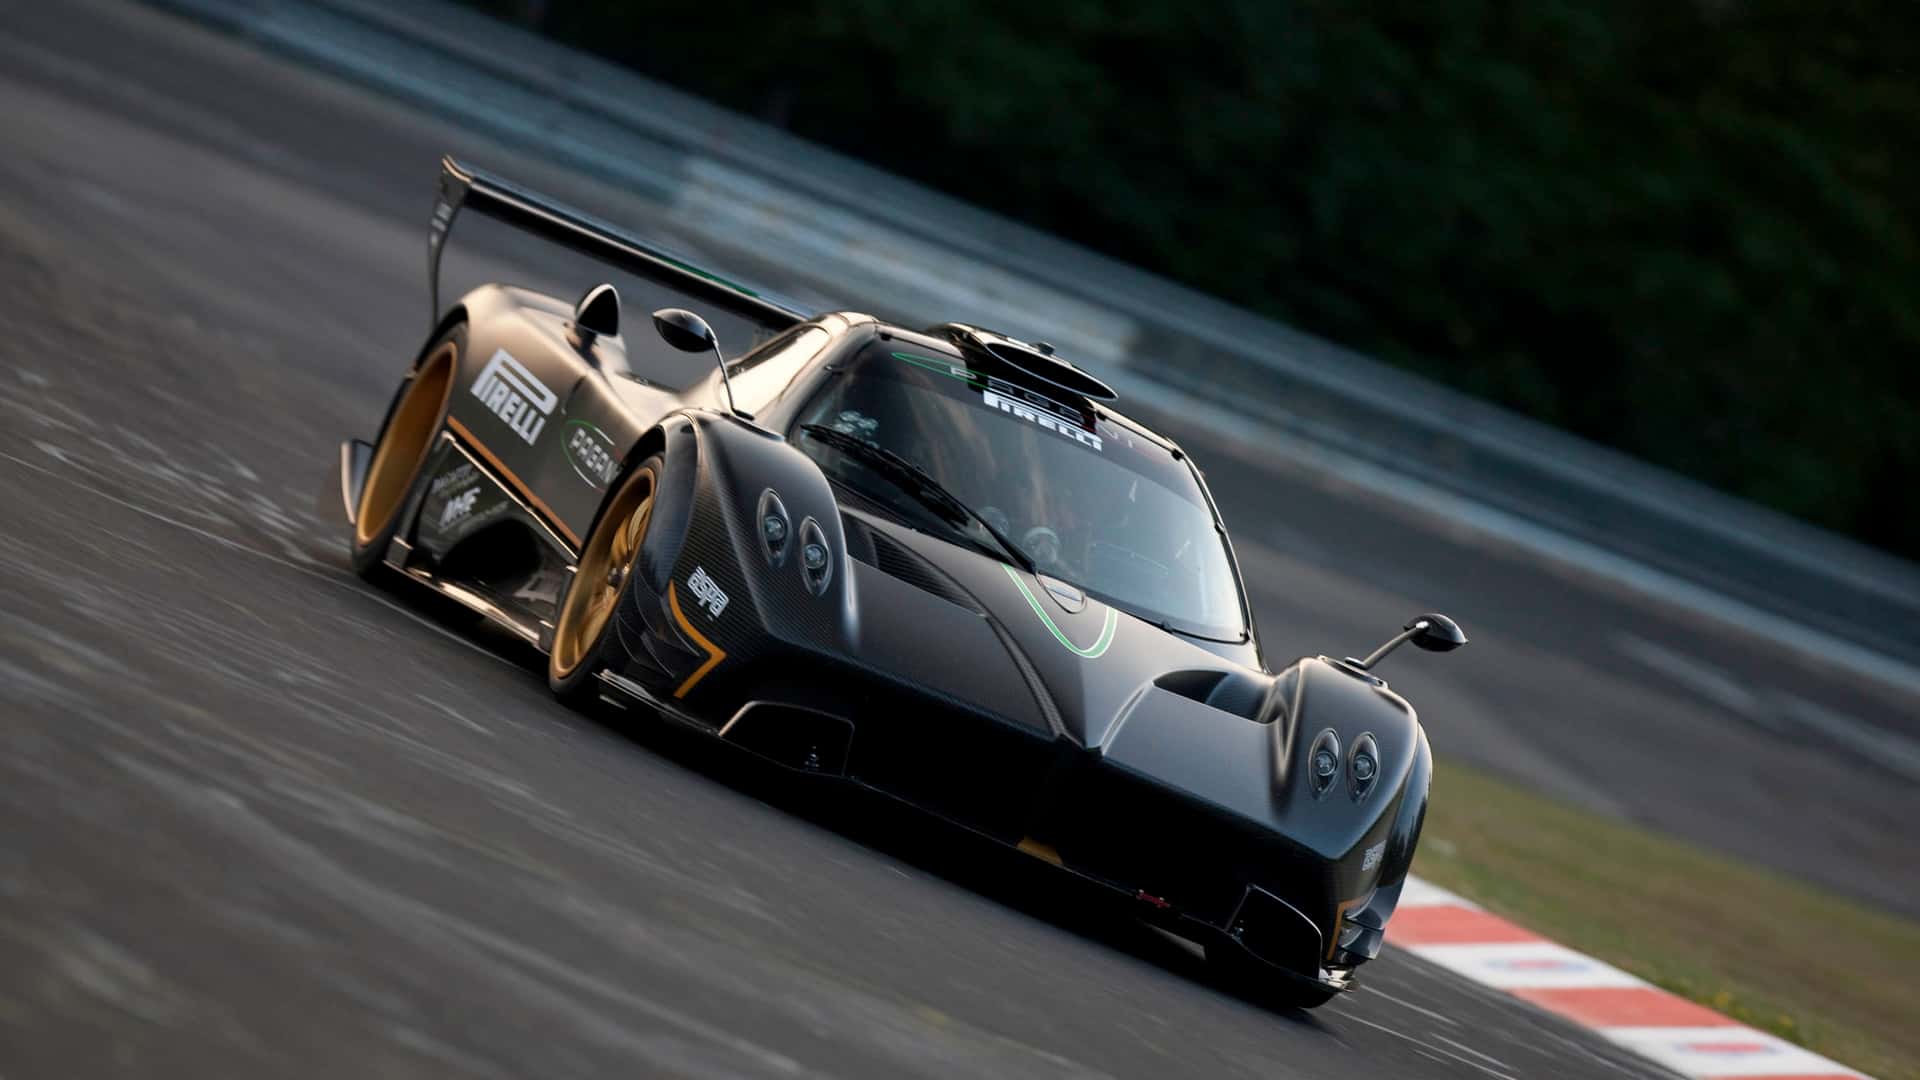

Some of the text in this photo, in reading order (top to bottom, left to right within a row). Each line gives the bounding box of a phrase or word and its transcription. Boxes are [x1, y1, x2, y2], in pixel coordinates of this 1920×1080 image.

[470, 348, 558, 446] PIRELLI
[983, 389, 1102, 451] PIRELLI
[567, 427, 622, 486] PAGAN
